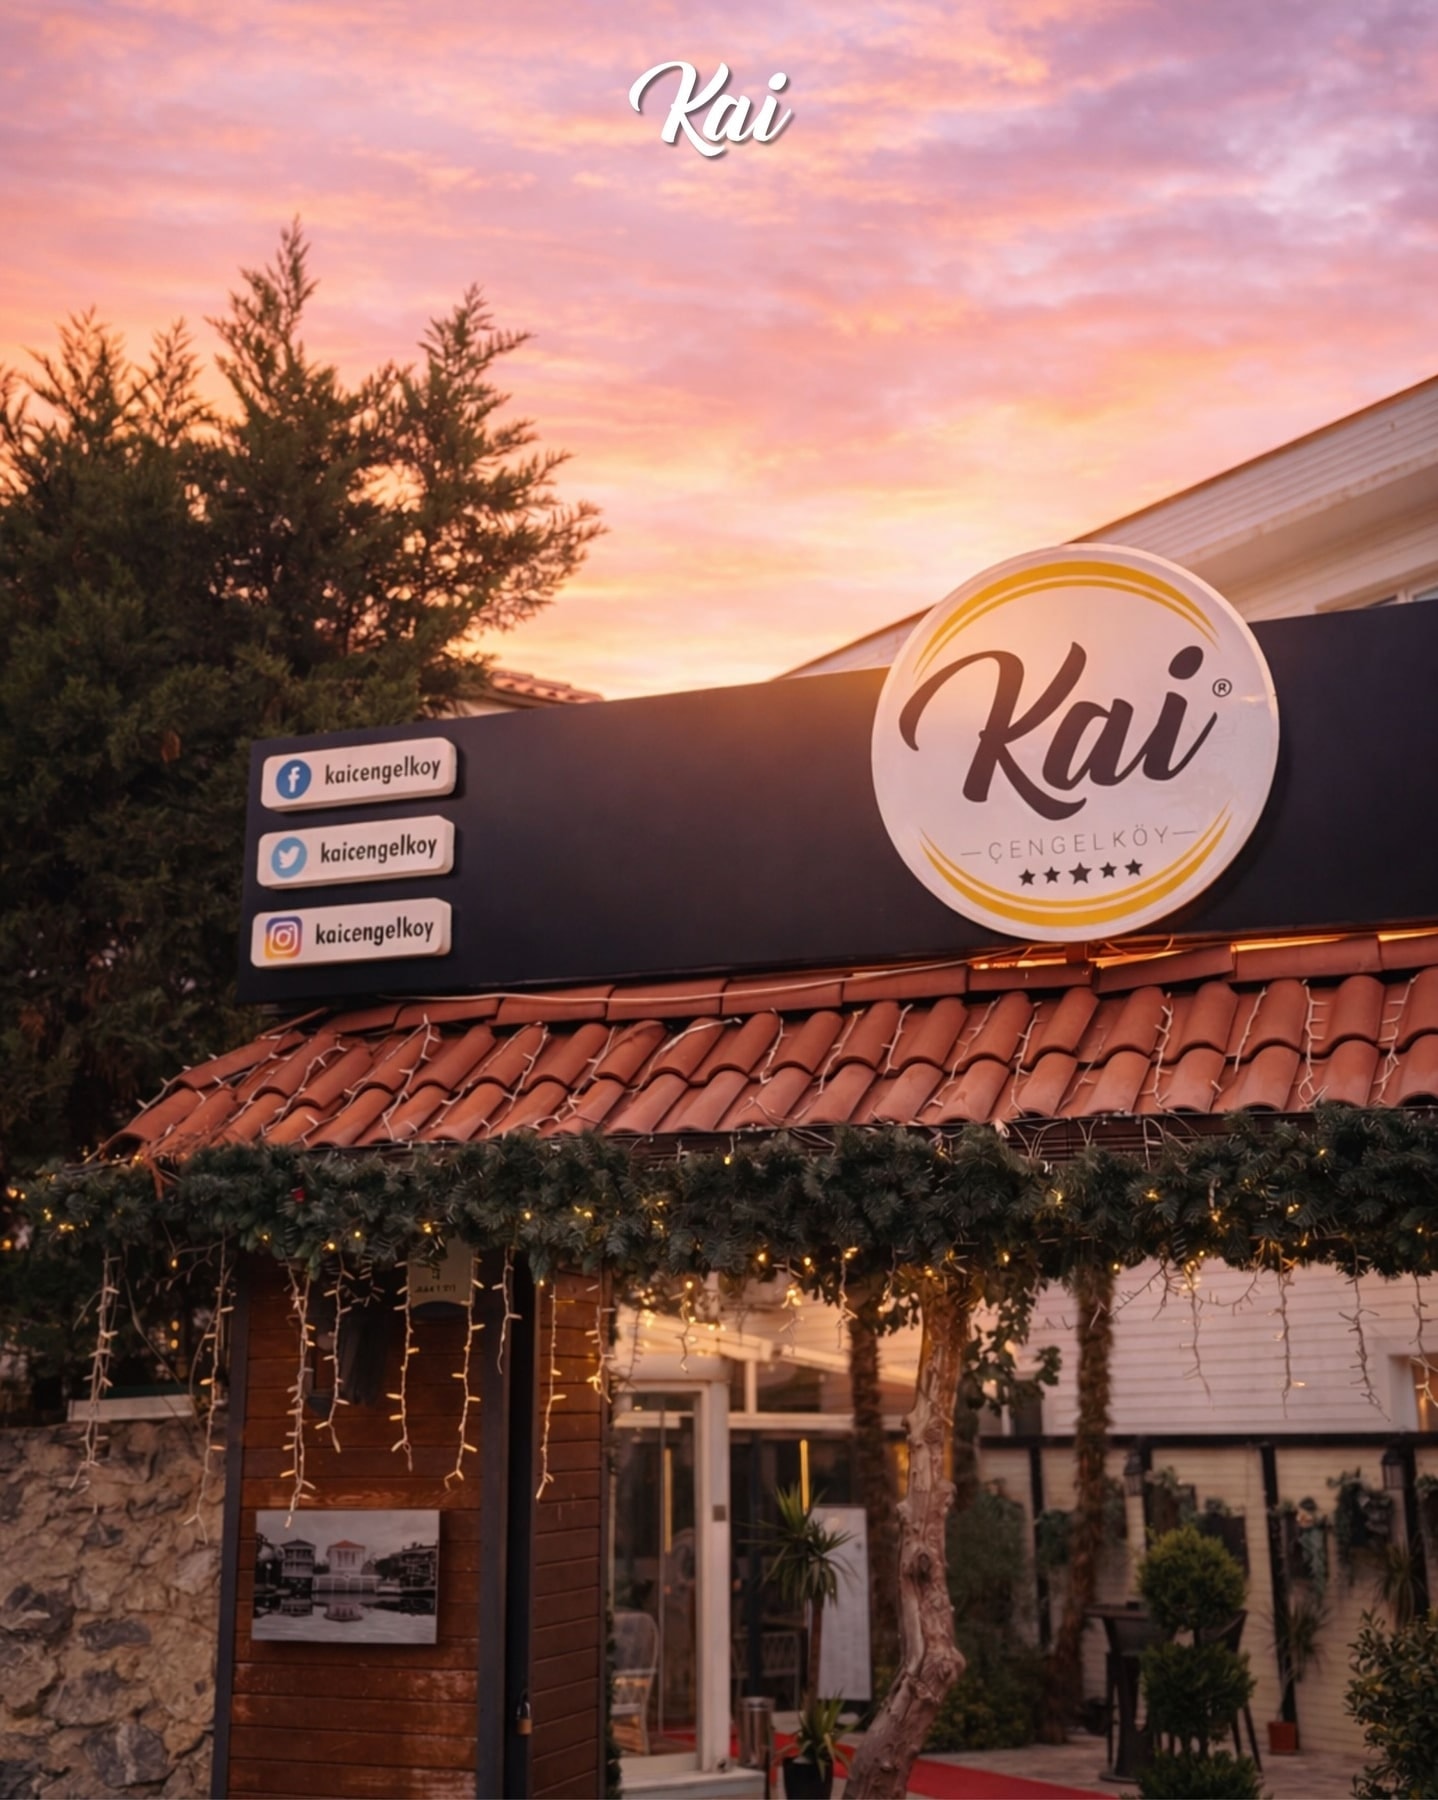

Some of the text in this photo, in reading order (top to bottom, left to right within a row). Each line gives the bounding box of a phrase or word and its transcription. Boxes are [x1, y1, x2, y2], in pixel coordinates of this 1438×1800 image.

[899, 641, 1218, 820] Kai
[324, 755, 442, 785] kaicengelkoy
[320, 833, 438, 864] kaicengelkoy
[988, 824, 1170, 865] ÇENGELKÖY
[315, 916, 435, 946] kaicengelkoy
